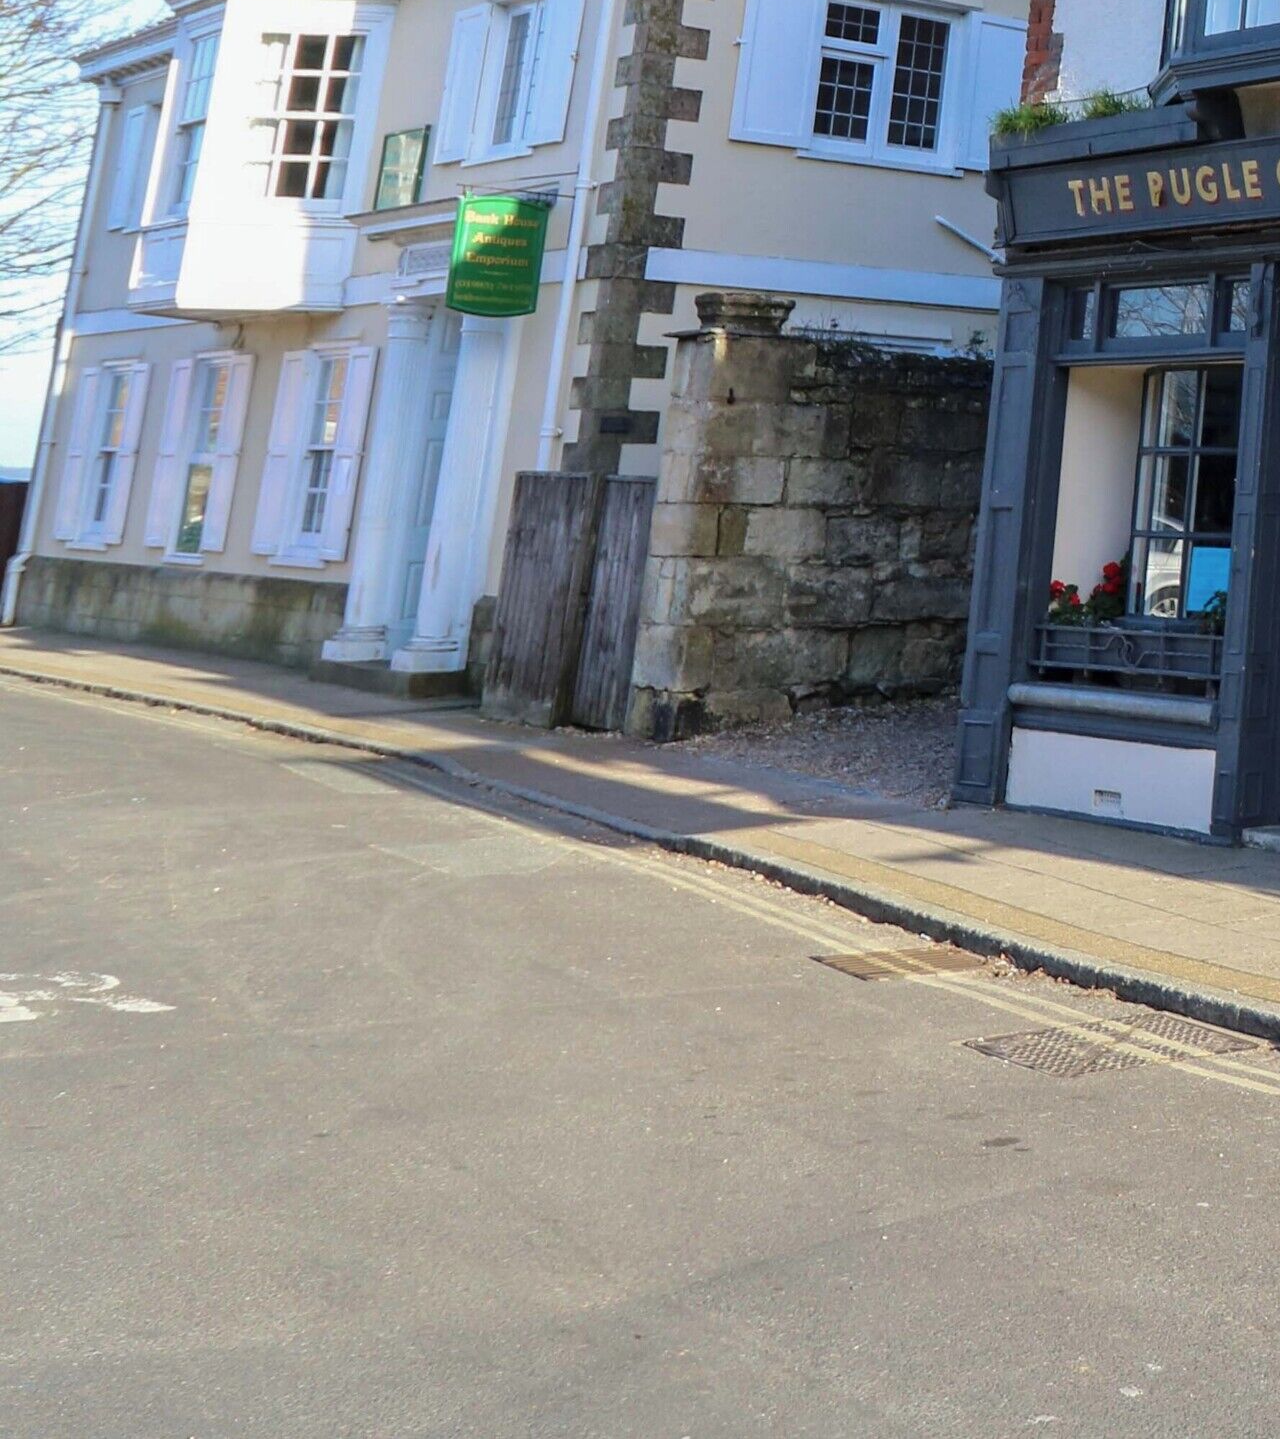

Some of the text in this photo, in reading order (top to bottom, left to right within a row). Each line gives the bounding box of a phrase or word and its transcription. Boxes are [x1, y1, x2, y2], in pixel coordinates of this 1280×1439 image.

[1067, 174, 1134, 216] THE
[472, 232, 528, 247] Antiques
[465, 251, 528, 267] Emporium
